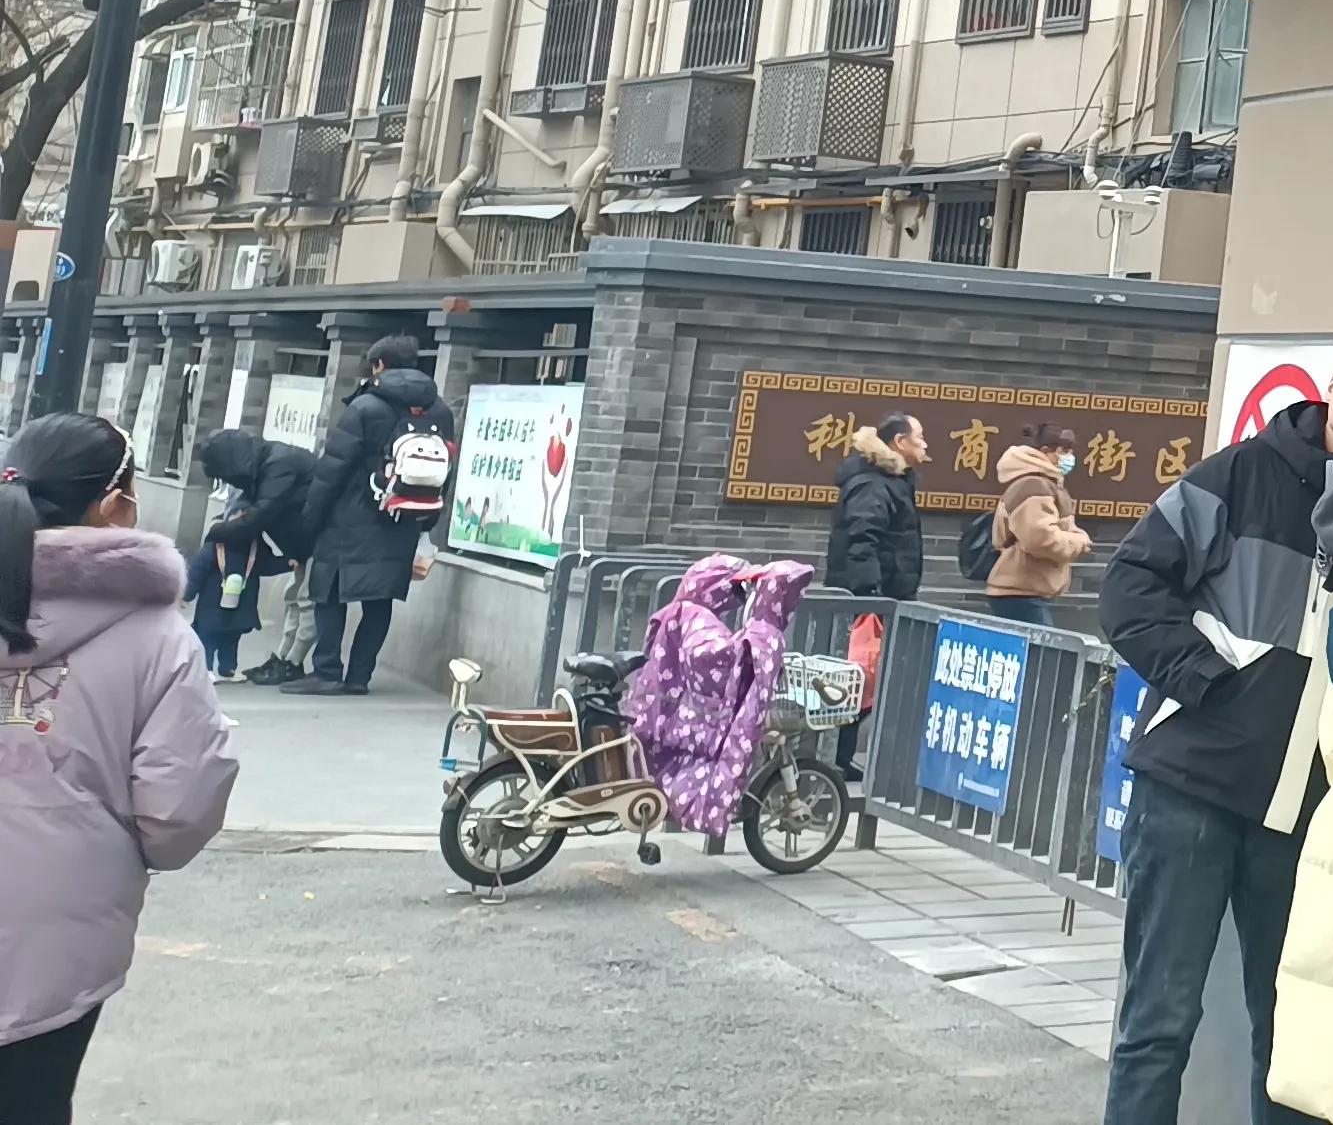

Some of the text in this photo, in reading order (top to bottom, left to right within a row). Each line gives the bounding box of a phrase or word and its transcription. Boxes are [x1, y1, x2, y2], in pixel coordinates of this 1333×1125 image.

[803, 411, 1194, 484] 科商街区
[933, 638, 1021, 704] 此处禁止停放
[925, 701, 1012, 771] 非机动车辆
